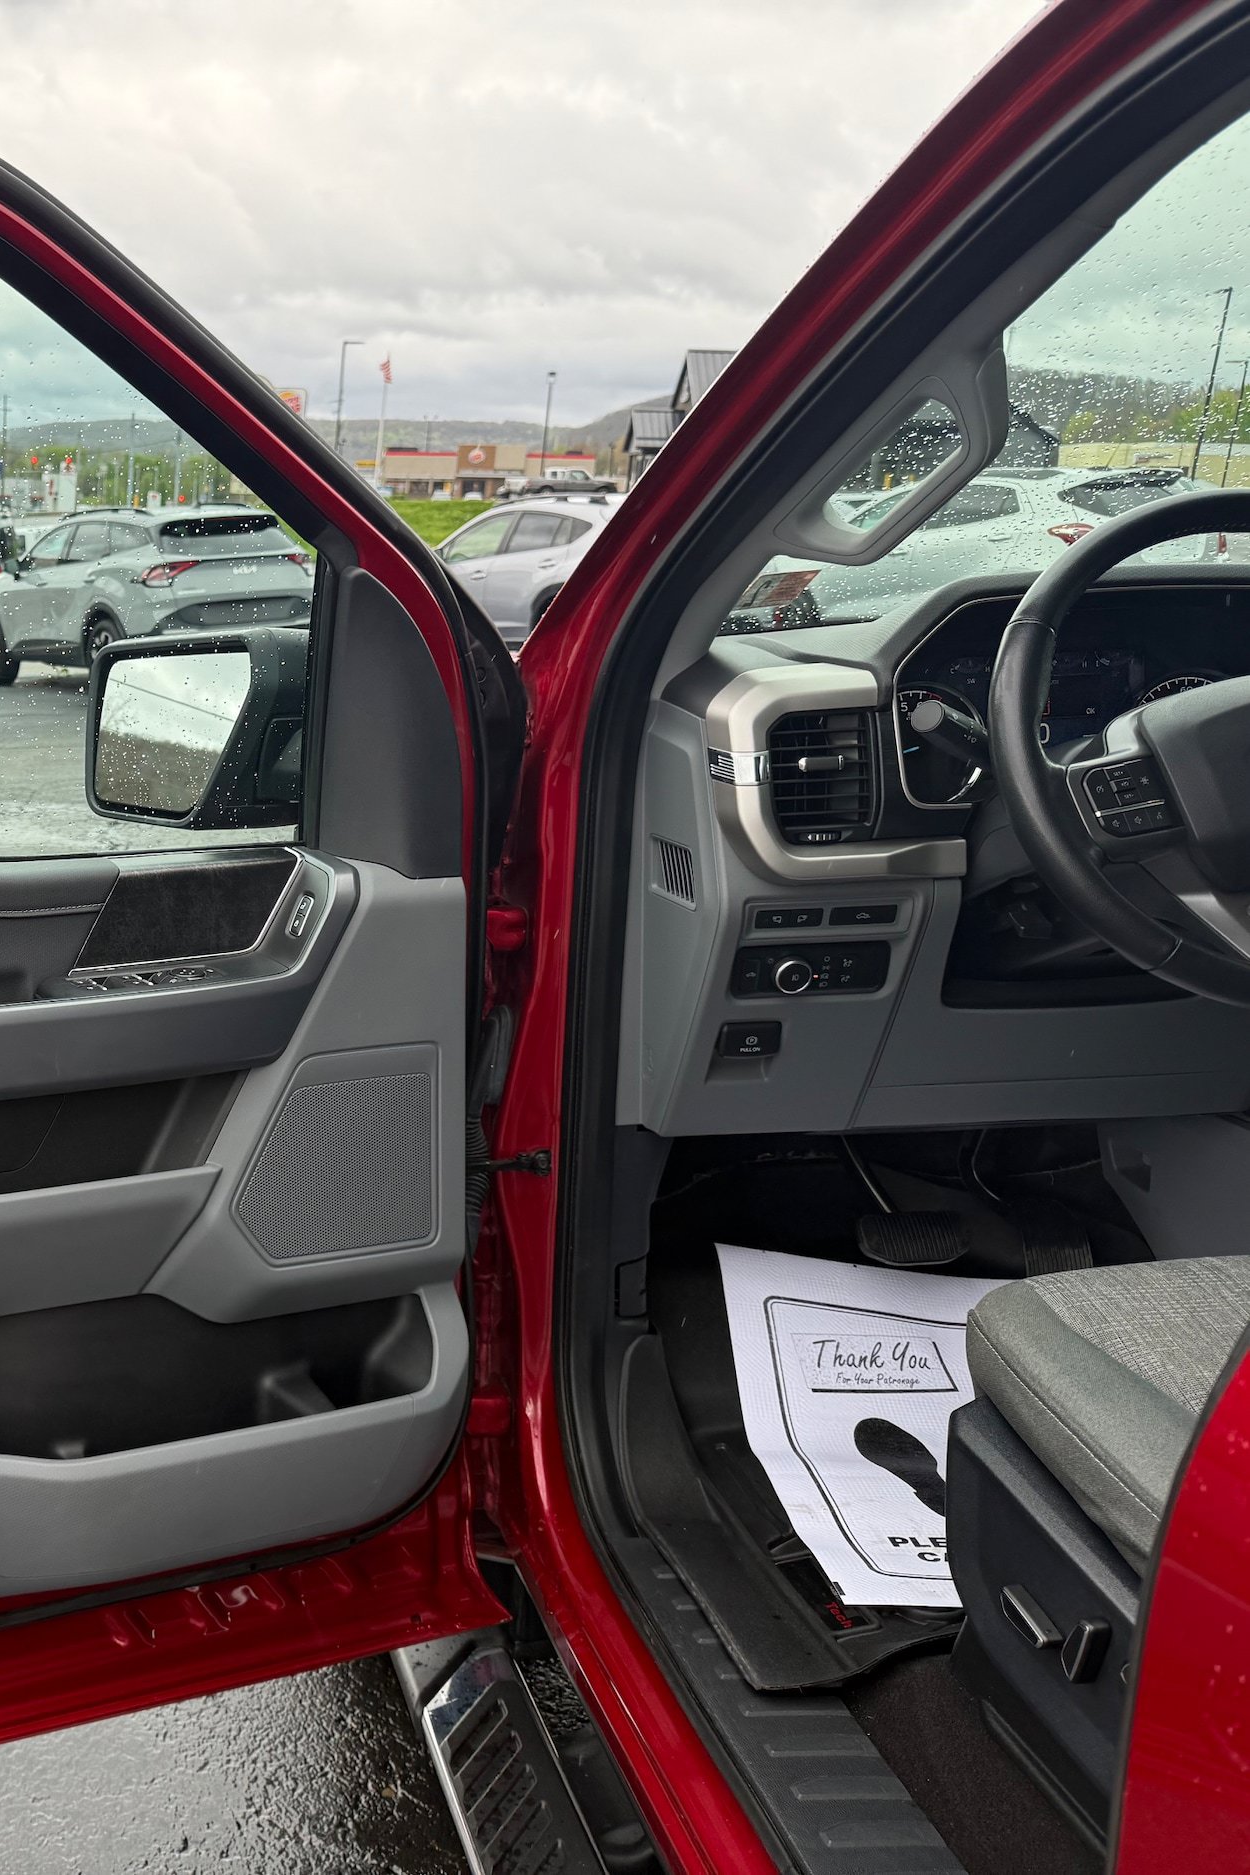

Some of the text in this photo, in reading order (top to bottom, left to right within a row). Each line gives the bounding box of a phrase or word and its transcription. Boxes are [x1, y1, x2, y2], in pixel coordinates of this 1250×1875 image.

[901, 702, 909, 712] 5
[812, 1339, 931, 1371] Thank You
[836, 1372, 920, 1388] For Your Patronage
